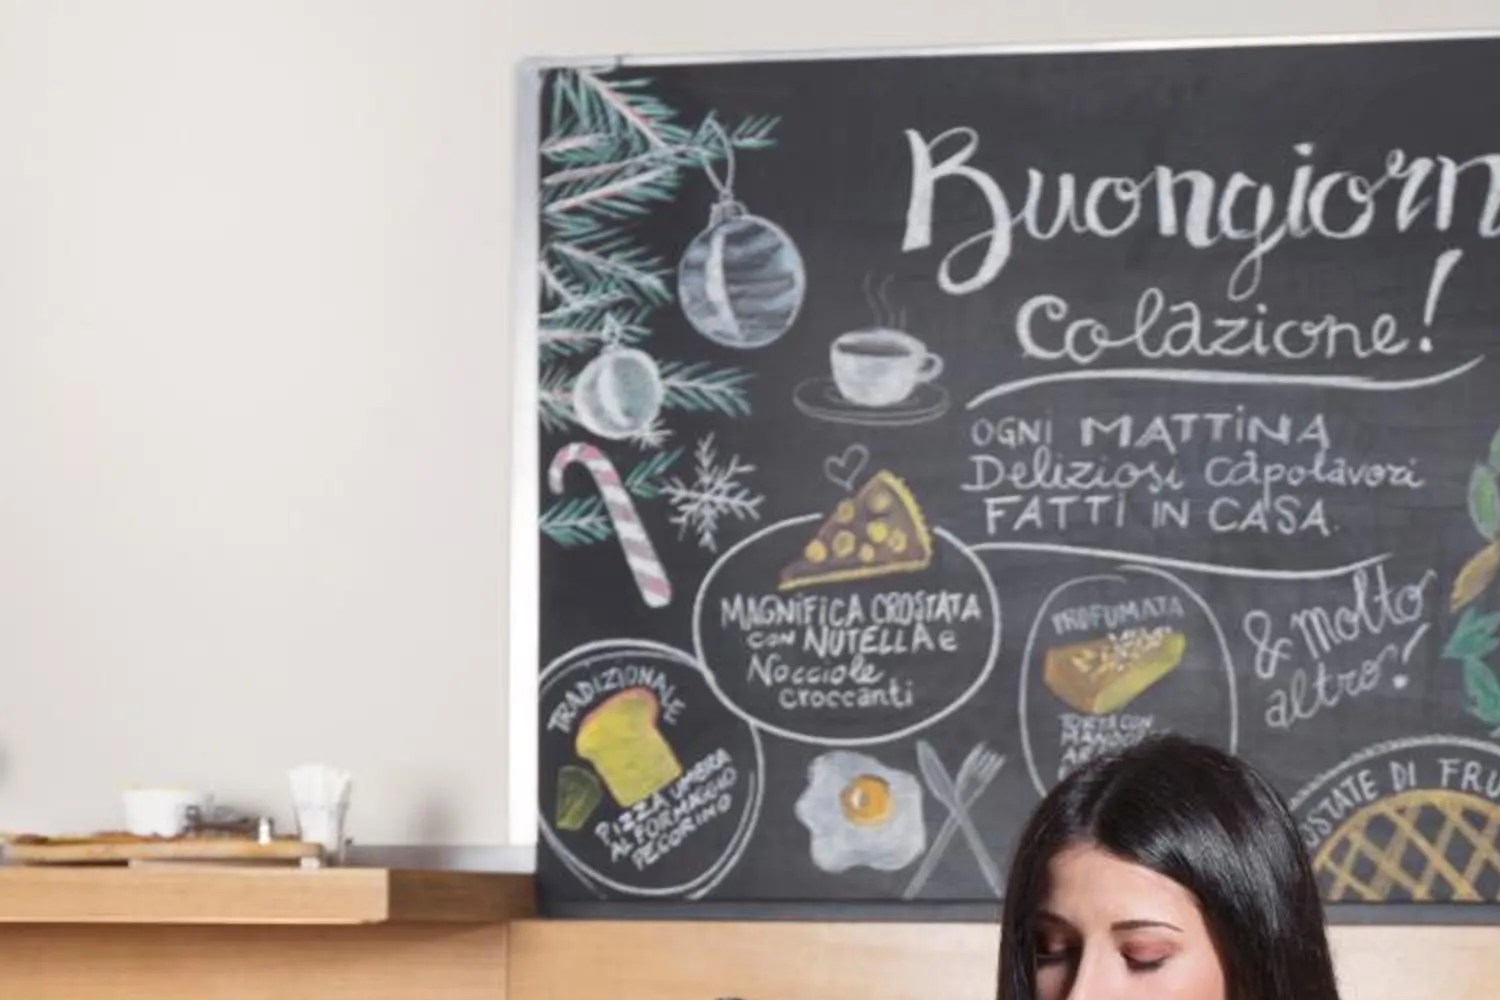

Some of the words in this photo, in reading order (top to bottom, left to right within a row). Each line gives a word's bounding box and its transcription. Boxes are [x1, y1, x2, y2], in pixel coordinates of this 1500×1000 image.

[1015, 248, 1464, 362] Colazione!
[960, 445, 1185, 493] Deliziosi
[983, 492, 1127, 536] FATTI
[1152, 500, 1189, 529] IN
[870, 591, 983, 626] CROSTATA
[802, 625, 936, 659] NUTELLA
[1243, 610, 1294, 679] &
[747, 652, 885, 687] Nocciole
[547, 665, 686, 734] TRADIZIONALE
[1298, 769, 1378, 849] OSTATE
[1389, 759, 1417, 793] DI
